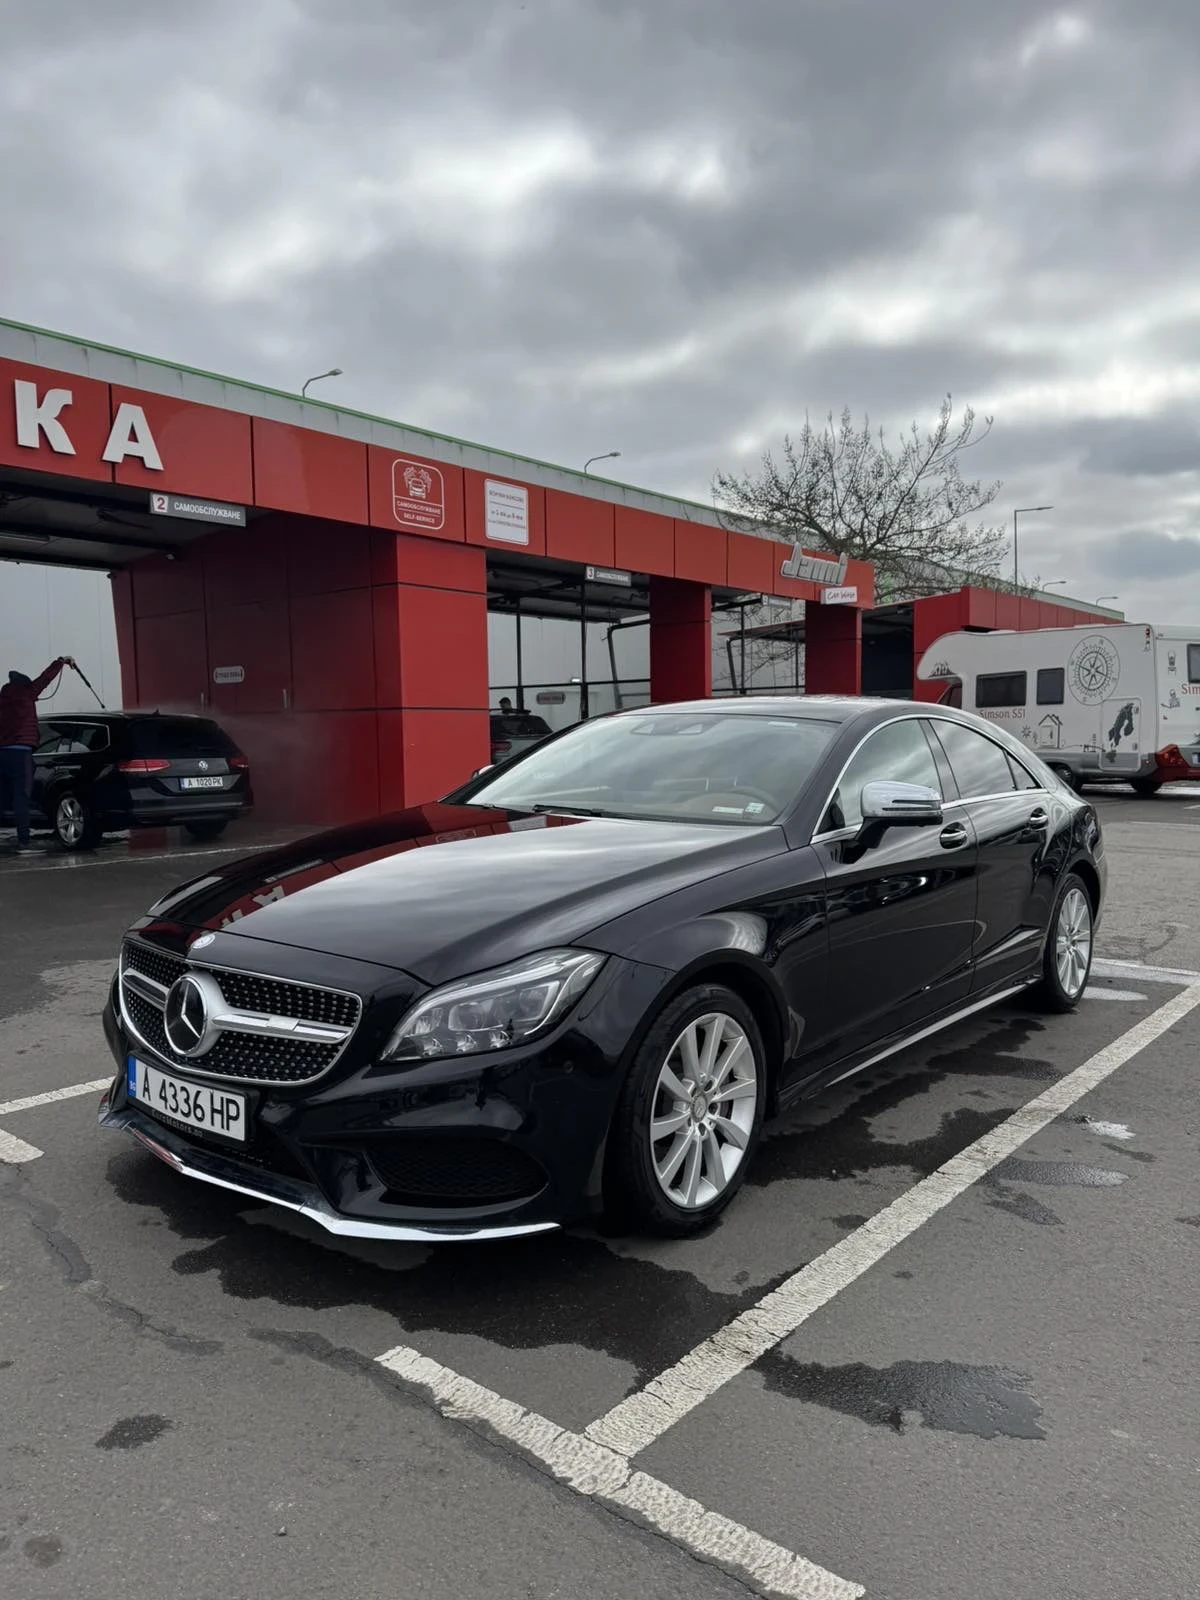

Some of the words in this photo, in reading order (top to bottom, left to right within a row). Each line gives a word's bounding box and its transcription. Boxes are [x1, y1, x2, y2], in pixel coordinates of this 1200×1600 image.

[157, 497, 165, 510] 2
[174, 502, 241, 520] САМООБСЛУЖВАНЕ
[588, 568, 593, 578] 3
[188, 779, 193, 787] A
[196, 777, 212, 786] 1020
[142, 1067, 152, 1101] A
[159, 1079, 205, 1122] 4336
[210, 1089, 240, 1131] HP
